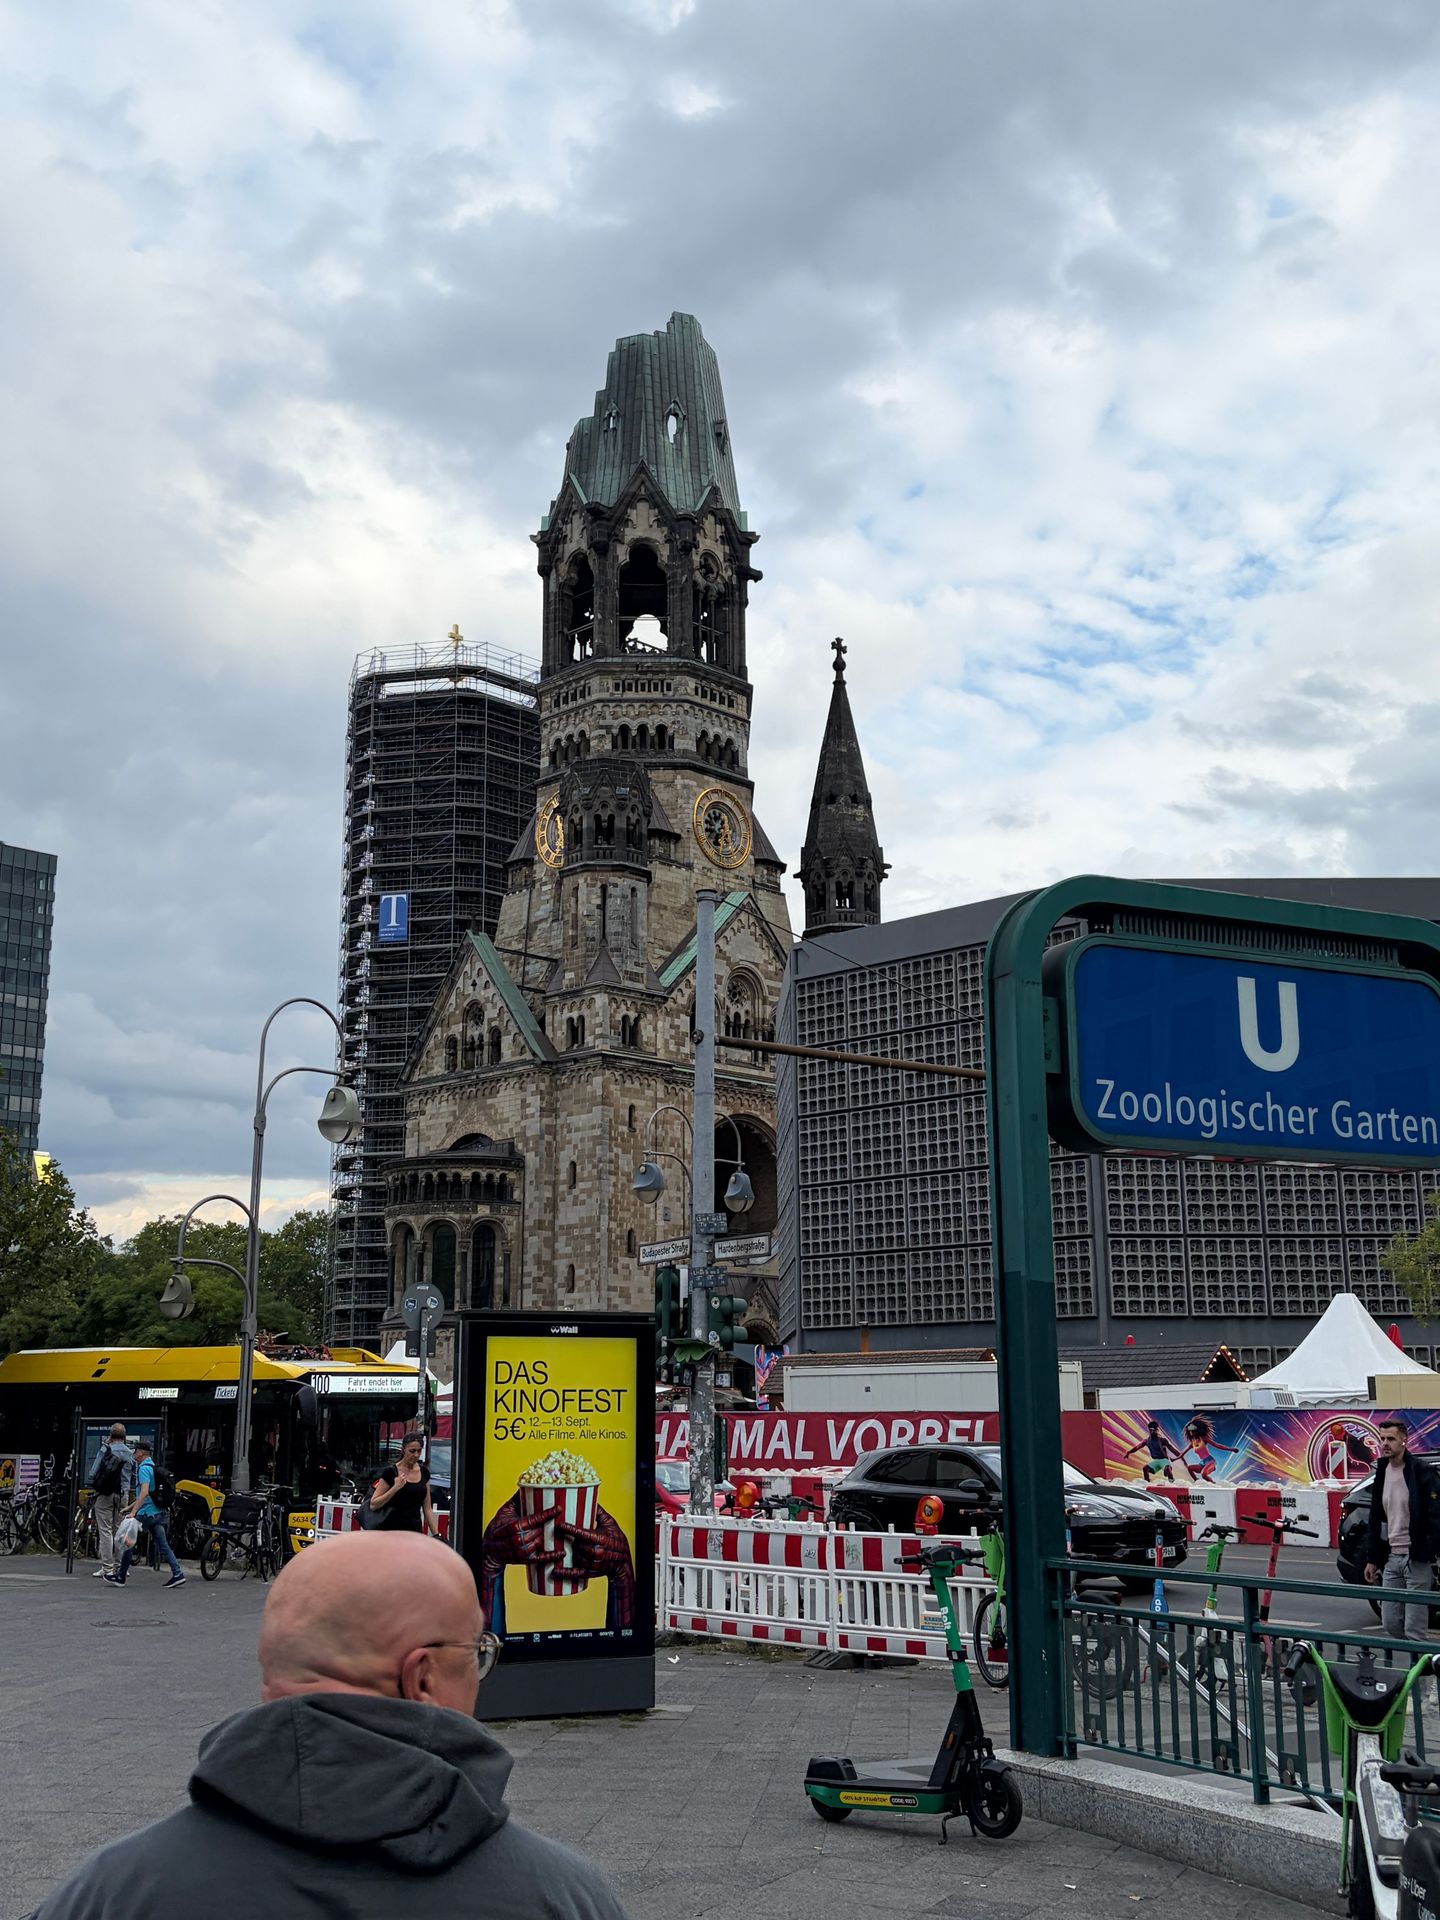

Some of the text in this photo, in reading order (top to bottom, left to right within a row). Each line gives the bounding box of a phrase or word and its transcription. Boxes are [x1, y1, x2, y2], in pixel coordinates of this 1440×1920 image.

[381, 894, 407, 927] T
[1237, 976, 1300, 1072] U
[1097, 1079, 1438, 1144] Zoologischer Garten
[641, 1242, 689, 1259] Budapester Straße
[718, 1239, 765, 1254] Hardenbergstraße
[560, 1326, 578, 1334] Wall
[311, 1375, 403, 1393] 100 Fahrt endet hier
[494, 1360, 549, 1385] DAS
[494, 1388, 628, 1413] KINOFEST
[493, 1417, 526, 1440] 5€
[528, 1428, 629, 1440] Alle Filme. Alle Kinos.
[565, 1416, 591, 1429] Sept.
[730, 1419, 814, 1460] MAL
[1154, 1599, 1162, 1612] do
[940, 1606, 952, 1629] Bolt
